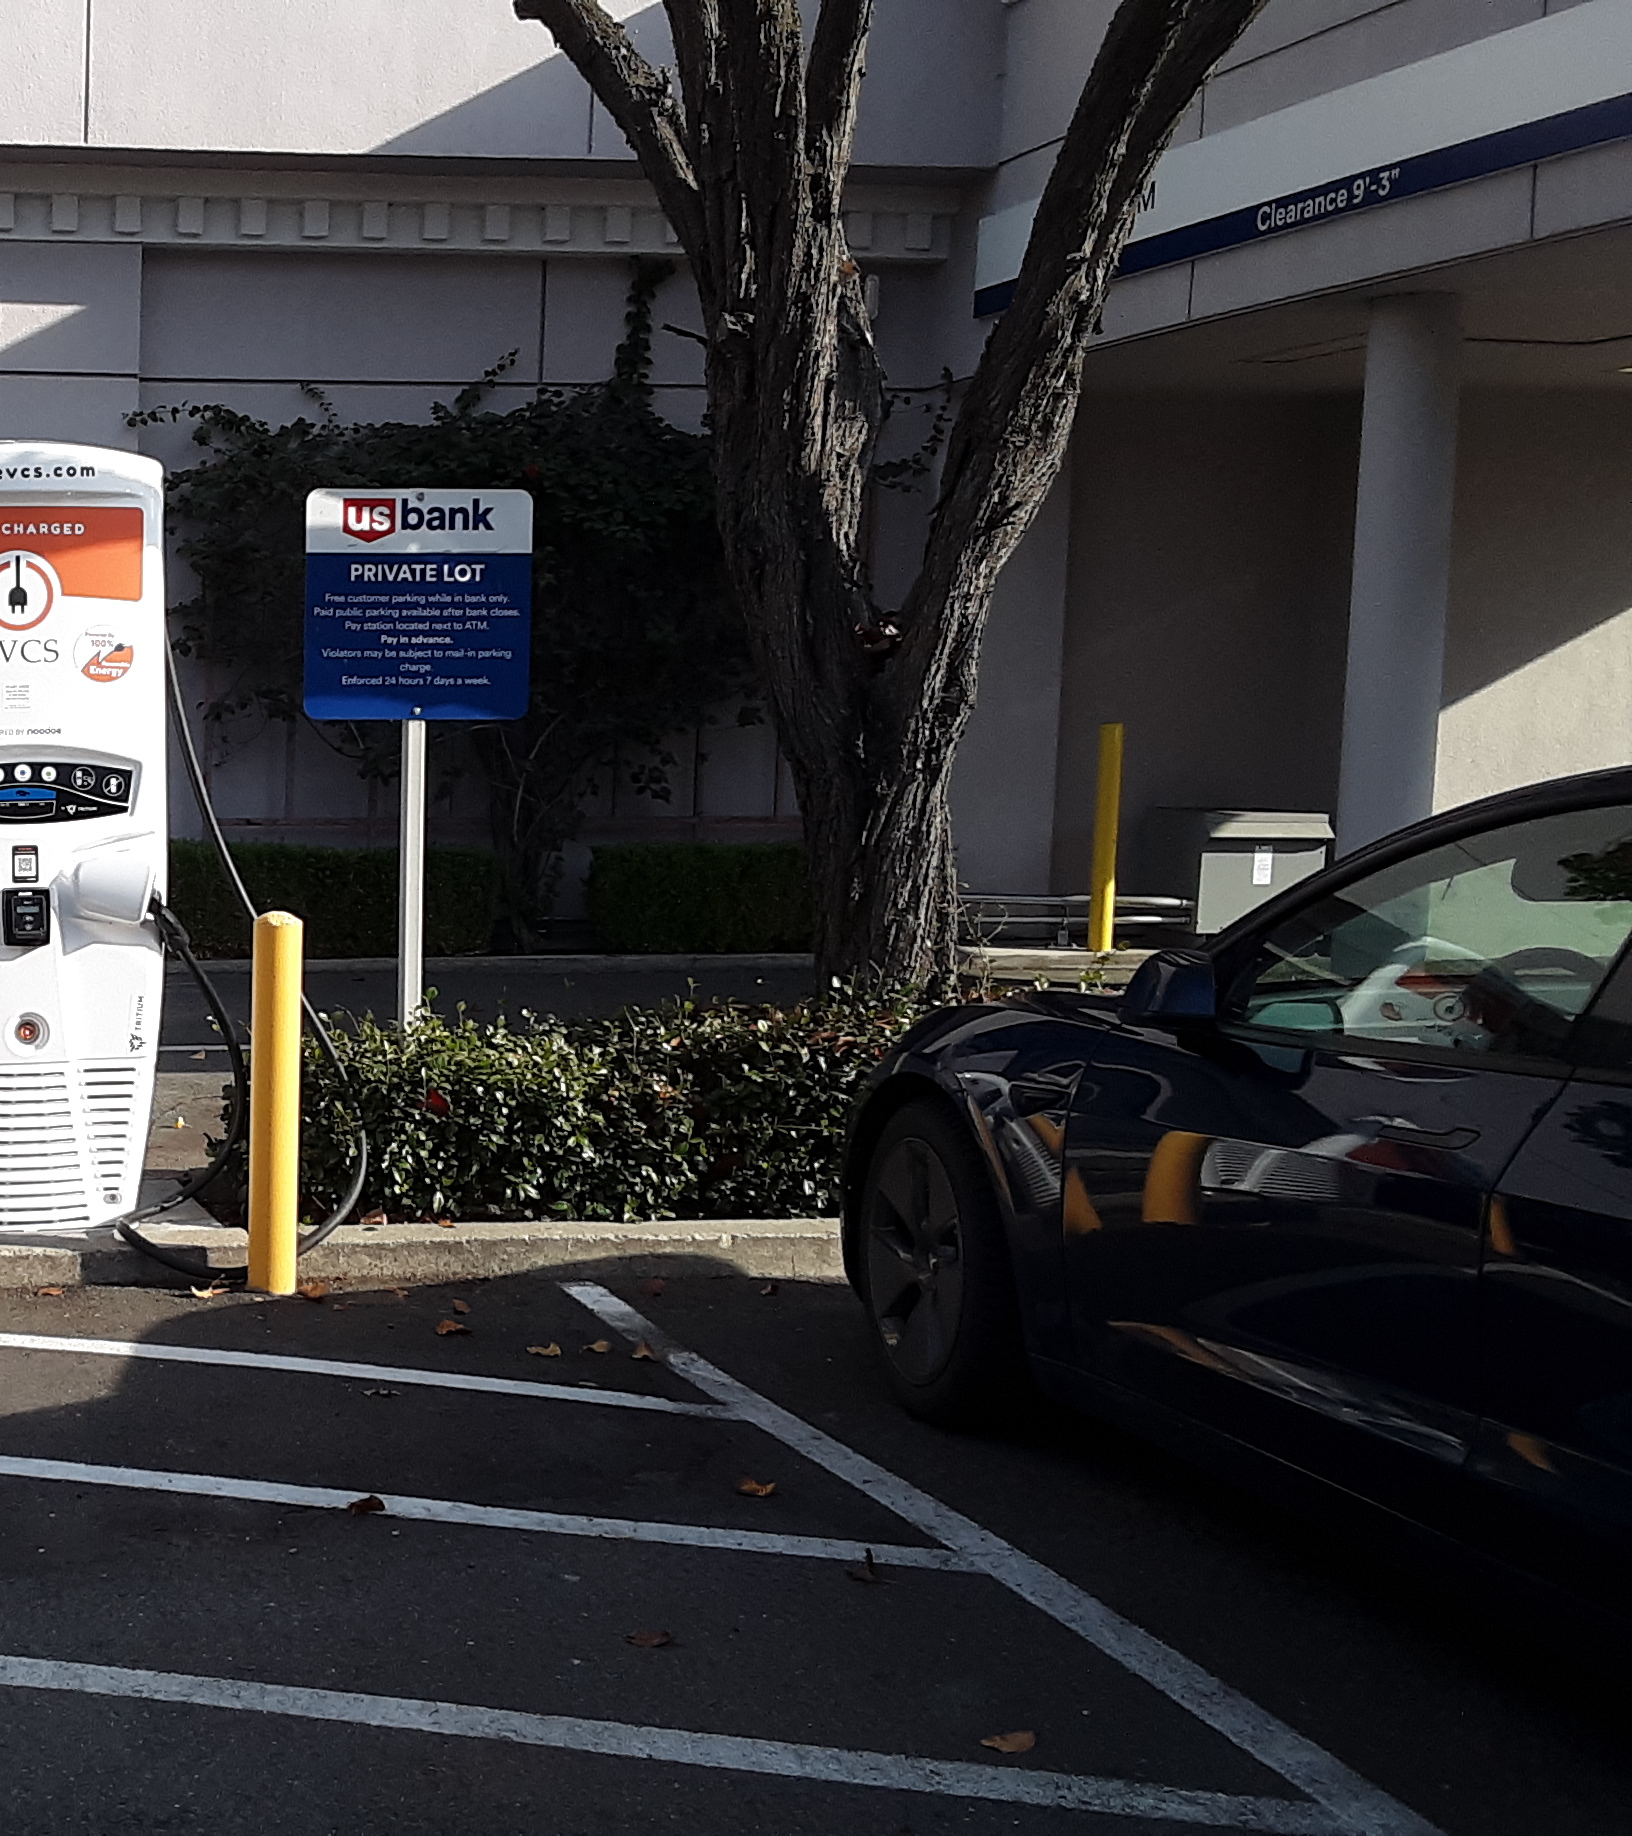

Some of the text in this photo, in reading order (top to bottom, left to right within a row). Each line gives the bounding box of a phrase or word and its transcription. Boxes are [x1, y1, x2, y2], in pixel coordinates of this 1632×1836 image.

[1256, 168, 1401, 232] Clearance 9'-3"
[401, 498, 495, 531] bank
[1, 523, 86, 535] CHARGED
[350, 564, 486, 582] PRIVATE LOT
[325, 593, 510, 605] Free customer parking while in bank only.
[313, 607, 334, 616] Paid
[335, 608, 363, 618] public
[365, 608, 399, 618] parking
[401, 608, 440, 616] available
[442, 607, 464, 616] after
[466, 608, 488, 616] bank
[344, 621, 489, 631] Pay station located next to ATM.
[381, 635, 454, 645] Pay in advance.
[321, 648, 513, 659] Violators may be subject to mail-in parking
[89, 665, 123, 677] Energy
[341, 675, 383, 685] Enforced
[384, 676, 397, 685] 24
[398, 676, 424, 685] hours
[425, 676, 432, 684] 7
[433, 676, 455, 686] days
